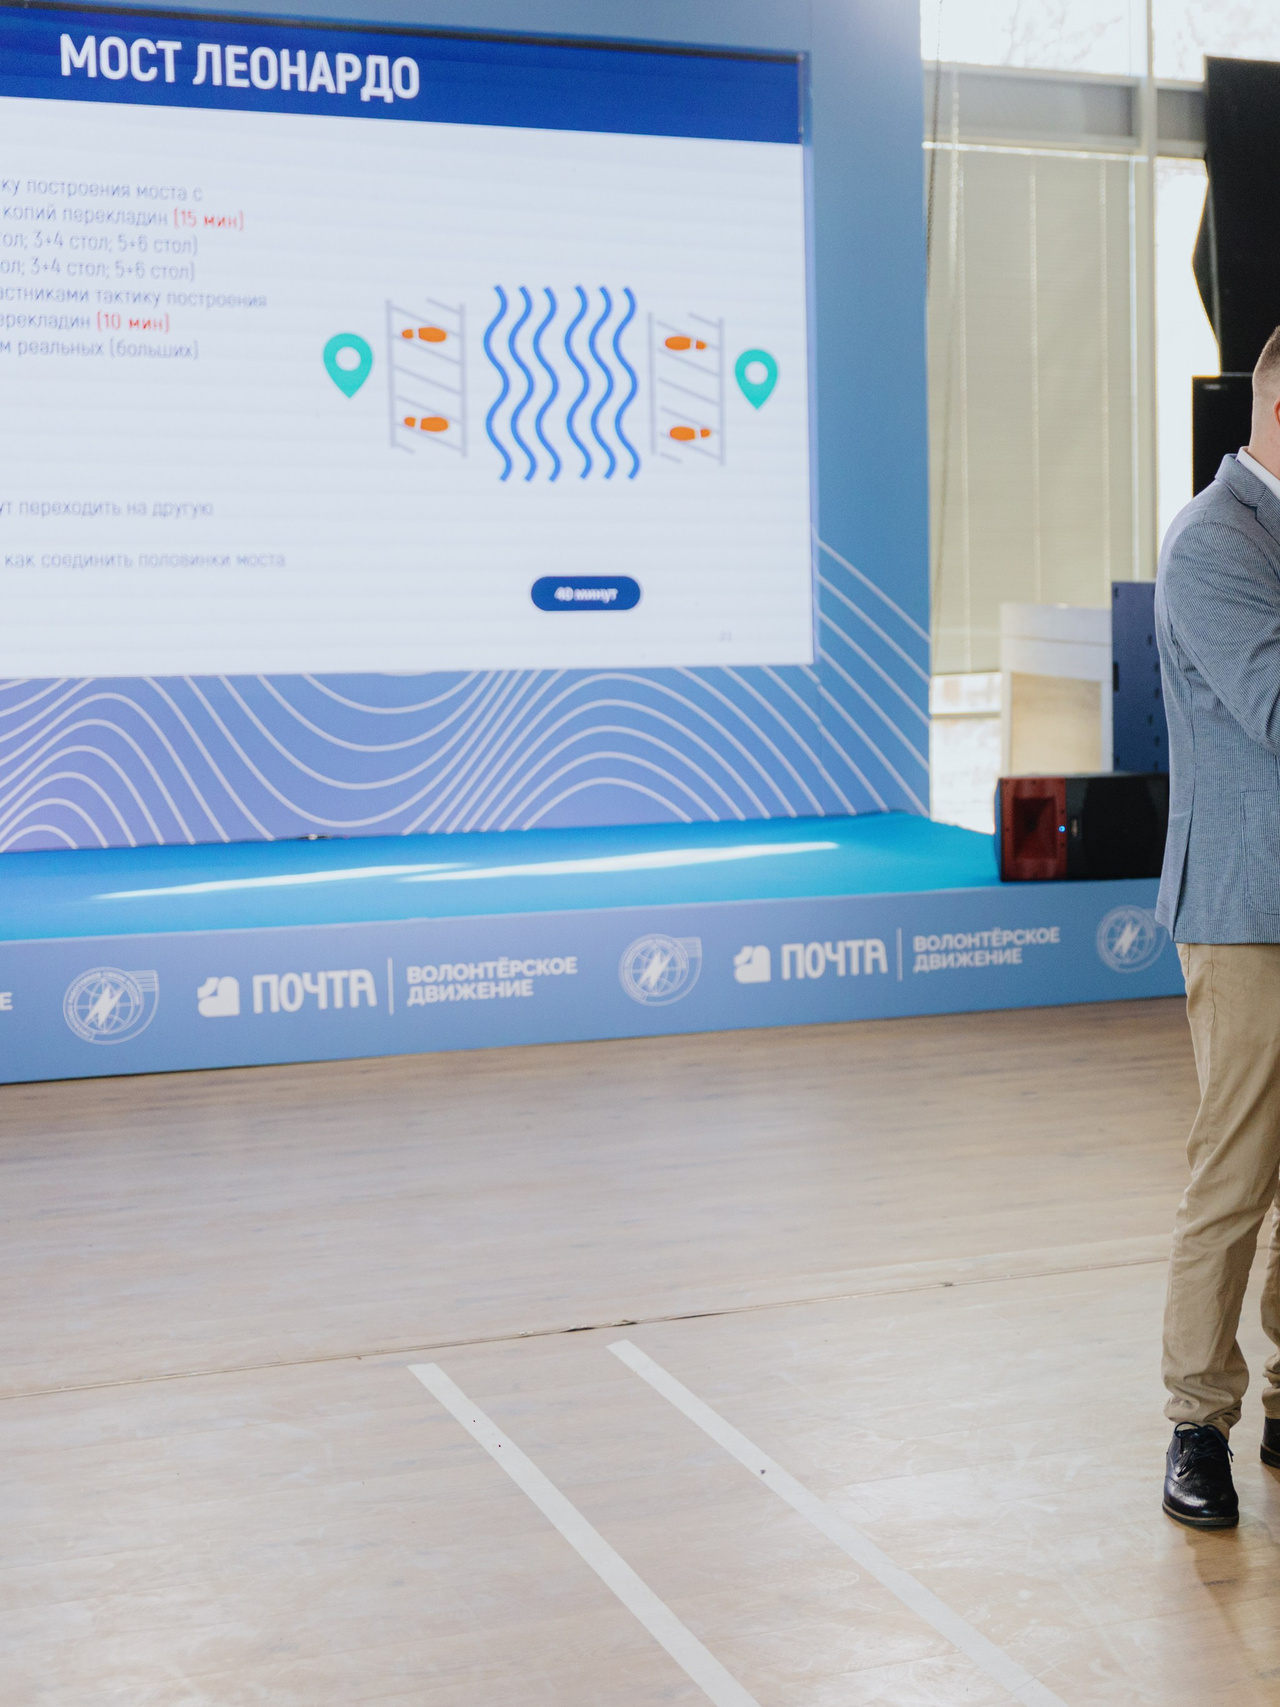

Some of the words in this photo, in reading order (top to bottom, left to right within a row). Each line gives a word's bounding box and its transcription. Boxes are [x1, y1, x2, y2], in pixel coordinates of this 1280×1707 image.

[60, 33, 182, 84] МОСТ
[193, 43, 421, 103] ЛЕОНАРДО
[27, 179, 131, 200] построения
[136, 184, 188, 201] моста
[192, 187, 204, 202] с
[3, 203, 57, 221] копий
[63, 207, 168, 228] перекладин
[33, 231, 64, 249] 3+4
[70, 234, 113, 254] стол;
[117, 233, 148, 253] 5+6
[153, 235, 199, 256] стол)
[30, 257, 61, 276] 3+4
[67, 261, 110, 280] стол;
[115, 260, 145, 279] 5+6
[150, 261, 196, 282] стол)
[96, 290, 161, 310] тактику
[167, 292, 268, 310] построения
[18, 338, 104, 358] реальных
[109, 337, 199, 361] (больших)
[19, 500, 121, 518] переходить
[126, 501, 148, 516] на
[152, 501, 215, 520] другую
[4, 552, 36, 569] как
[41, 553, 134, 571] соединить
[138, 553, 231, 569] половинки
[236, 553, 287, 569] моста
[912, 926, 1061, 954] ВОЛОНТЁРСКОЕ
[406, 956, 579, 985] ВОЛОНТЁРСКОЕ
[781, 938, 888, 981] ПОЧТА
[912, 946, 1024, 974] ДВИЖЕНИЕ
[253, 968, 378, 1015] ПОЧТА
[406, 977, 536, 1008] ДВИЖЕНИЕ
